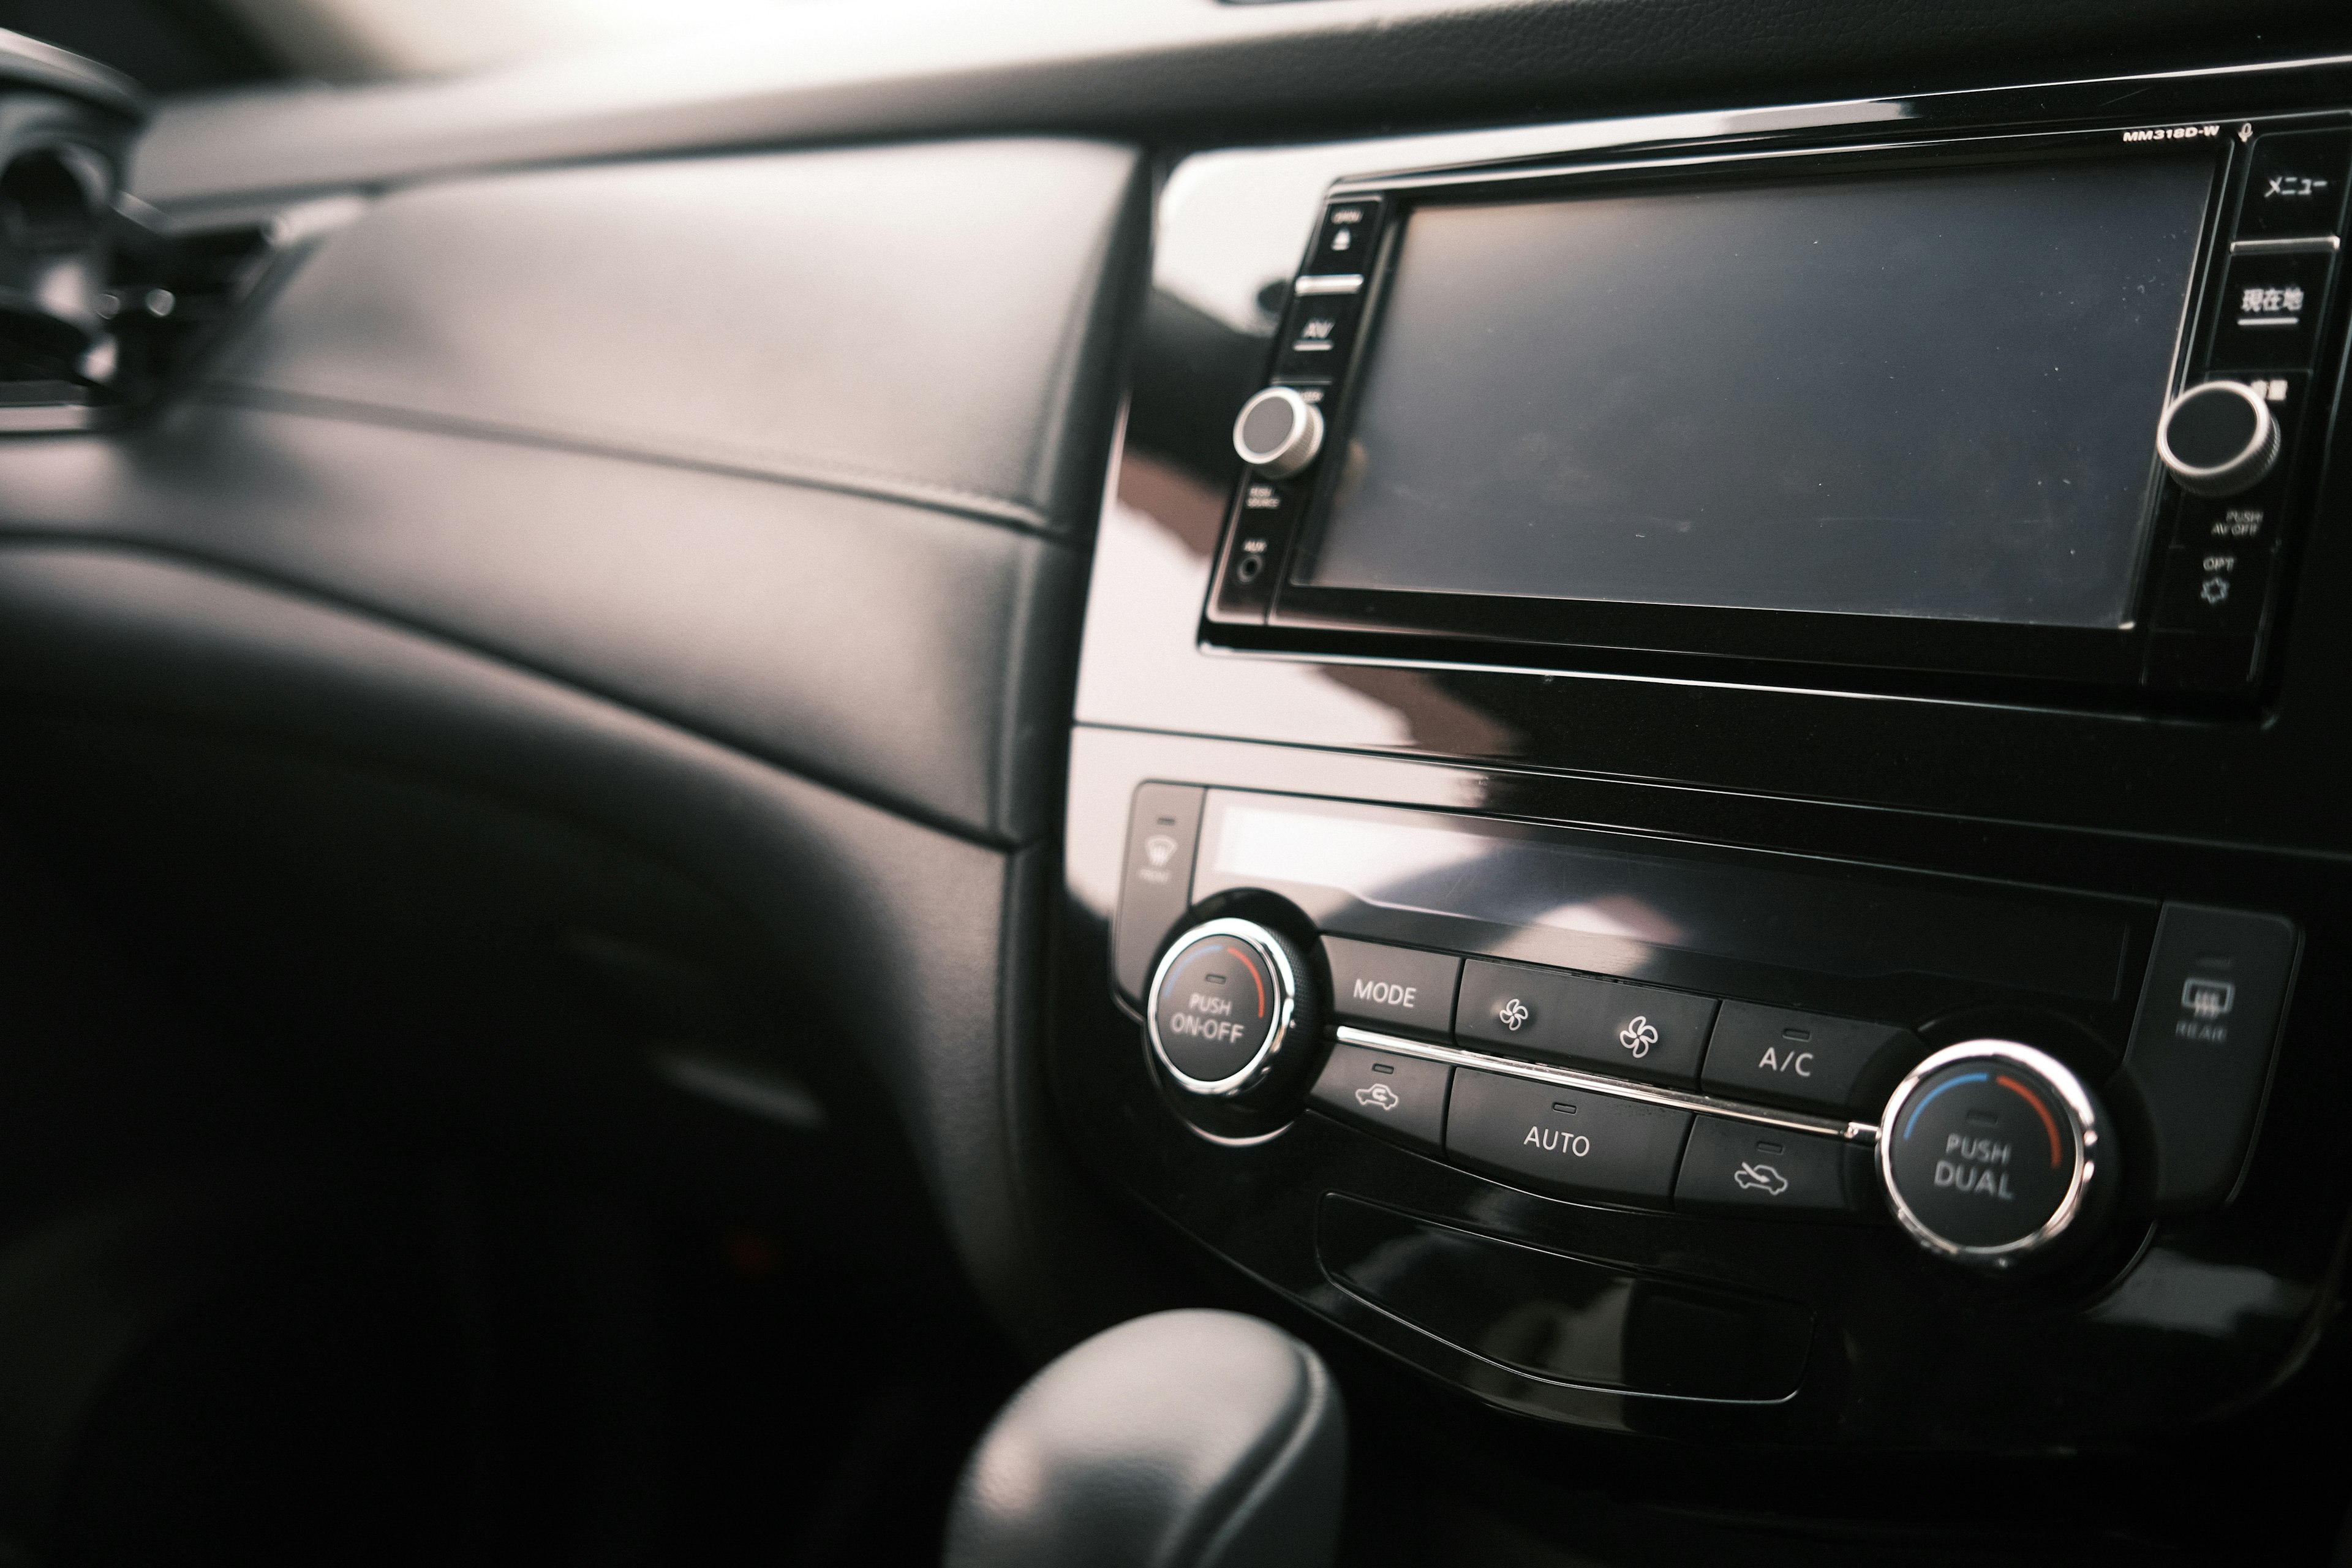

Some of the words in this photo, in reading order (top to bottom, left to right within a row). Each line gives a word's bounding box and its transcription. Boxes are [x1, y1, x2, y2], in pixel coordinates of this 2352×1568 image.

[2122, 125, 2220, 141] MM318D-W
[2264, 176, 2328, 197] メニュー
[2203, 557, 2235, 571] OPT
[1189, 993, 1231, 1016] PUSH
[1353, 979, 1417, 1008] MODE
[1758, 1047, 1814, 1077] A/C
[1523, 1126, 1590, 1157] AUTO
[1946, 1134, 2011, 1165] PUSH
[1934, 1161, 2014, 1200] DUAL
